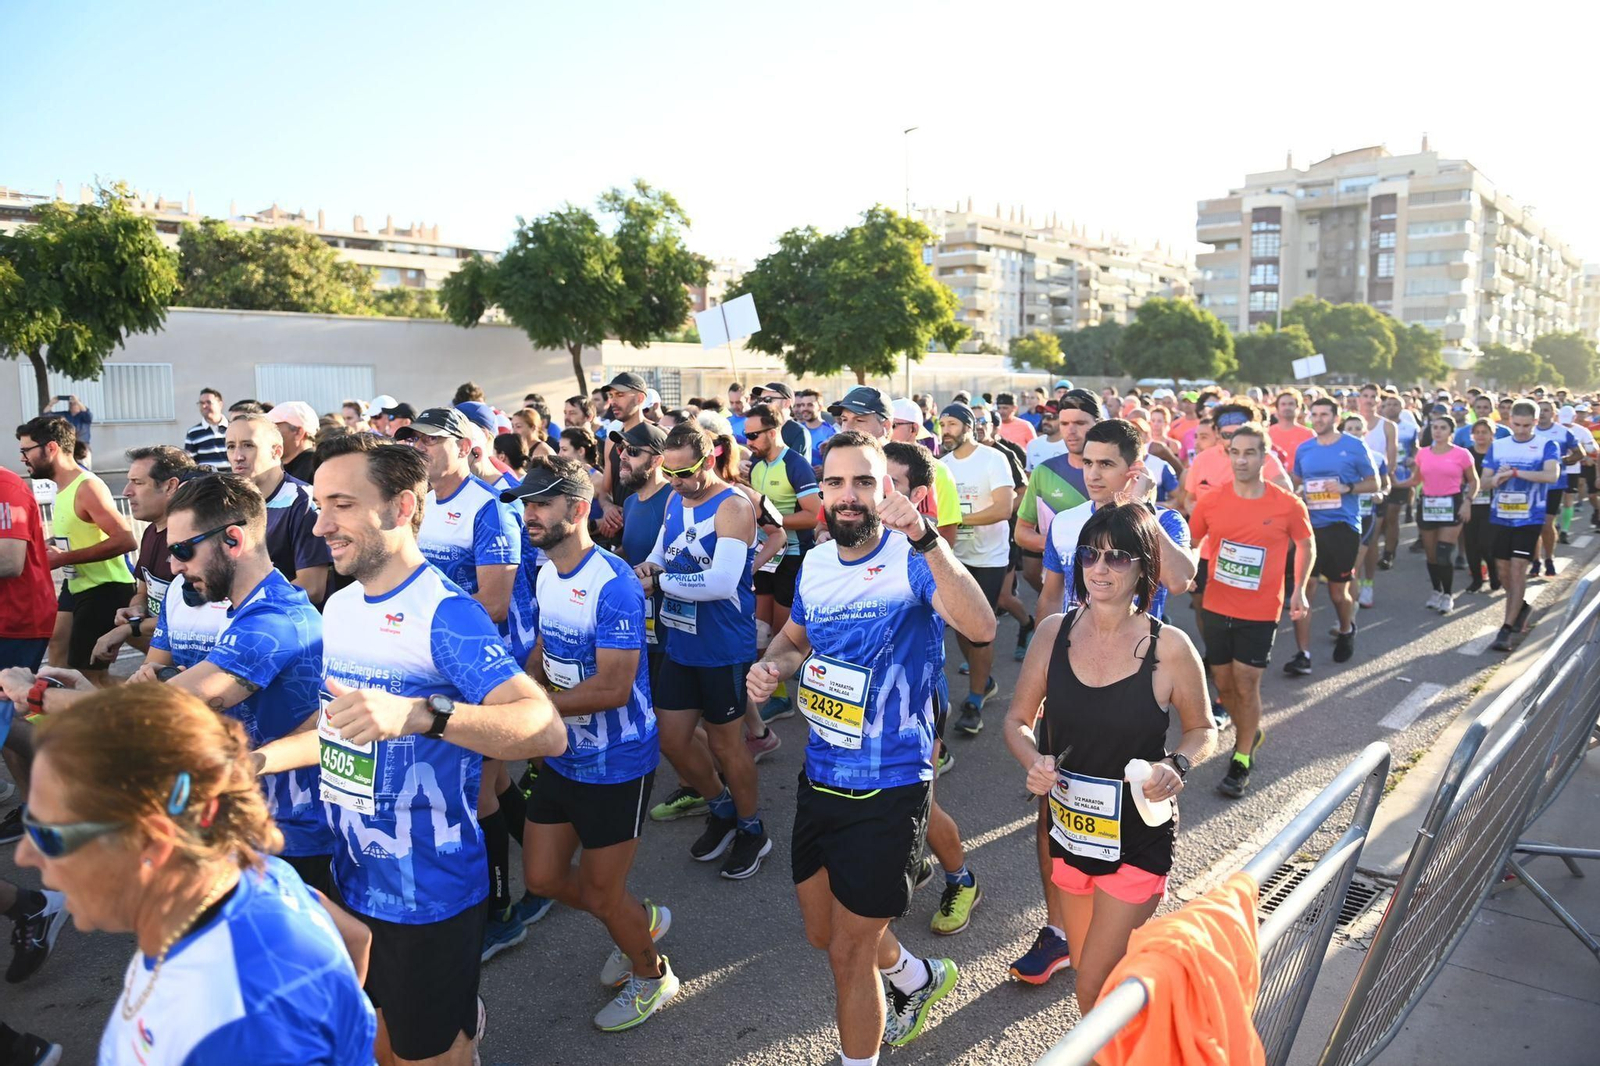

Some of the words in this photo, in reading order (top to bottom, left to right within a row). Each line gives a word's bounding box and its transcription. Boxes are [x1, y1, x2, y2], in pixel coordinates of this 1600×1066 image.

[1223, 562, 1249, 576] 4541
[666, 600, 682, 615] 642
[327, 657, 390, 680] TotalEnergies
[390, 668, 402, 694] 2022
[810, 693, 844, 720] 2432
[322, 746, 355, 777] 4505
[1059, 807, 1096, 833] 2168
